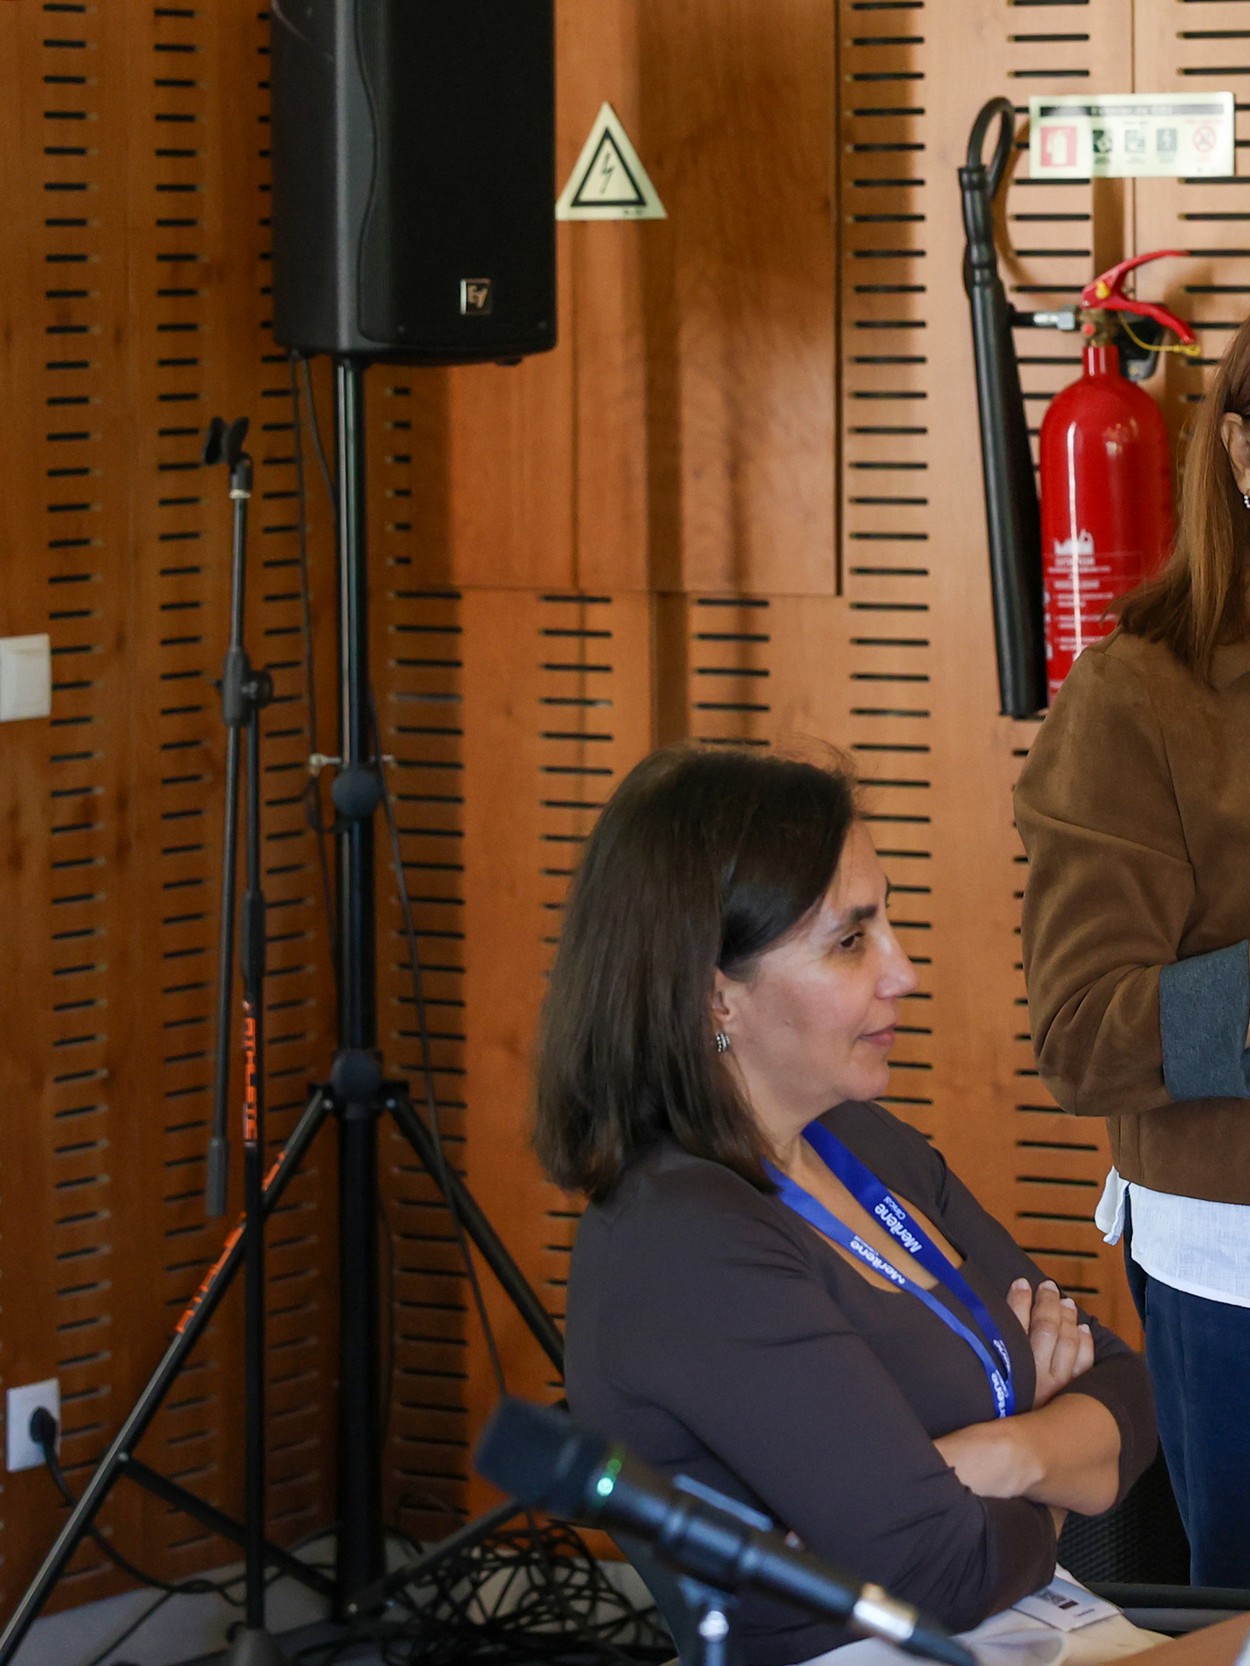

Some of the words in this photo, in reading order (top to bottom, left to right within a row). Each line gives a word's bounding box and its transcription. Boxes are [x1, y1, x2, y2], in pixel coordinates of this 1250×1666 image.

[874, 1202, 923, 1253] Meritene
[883, 1196, 905, 1221] Clinical
[850, 1240, 905, 1285] Meritene
